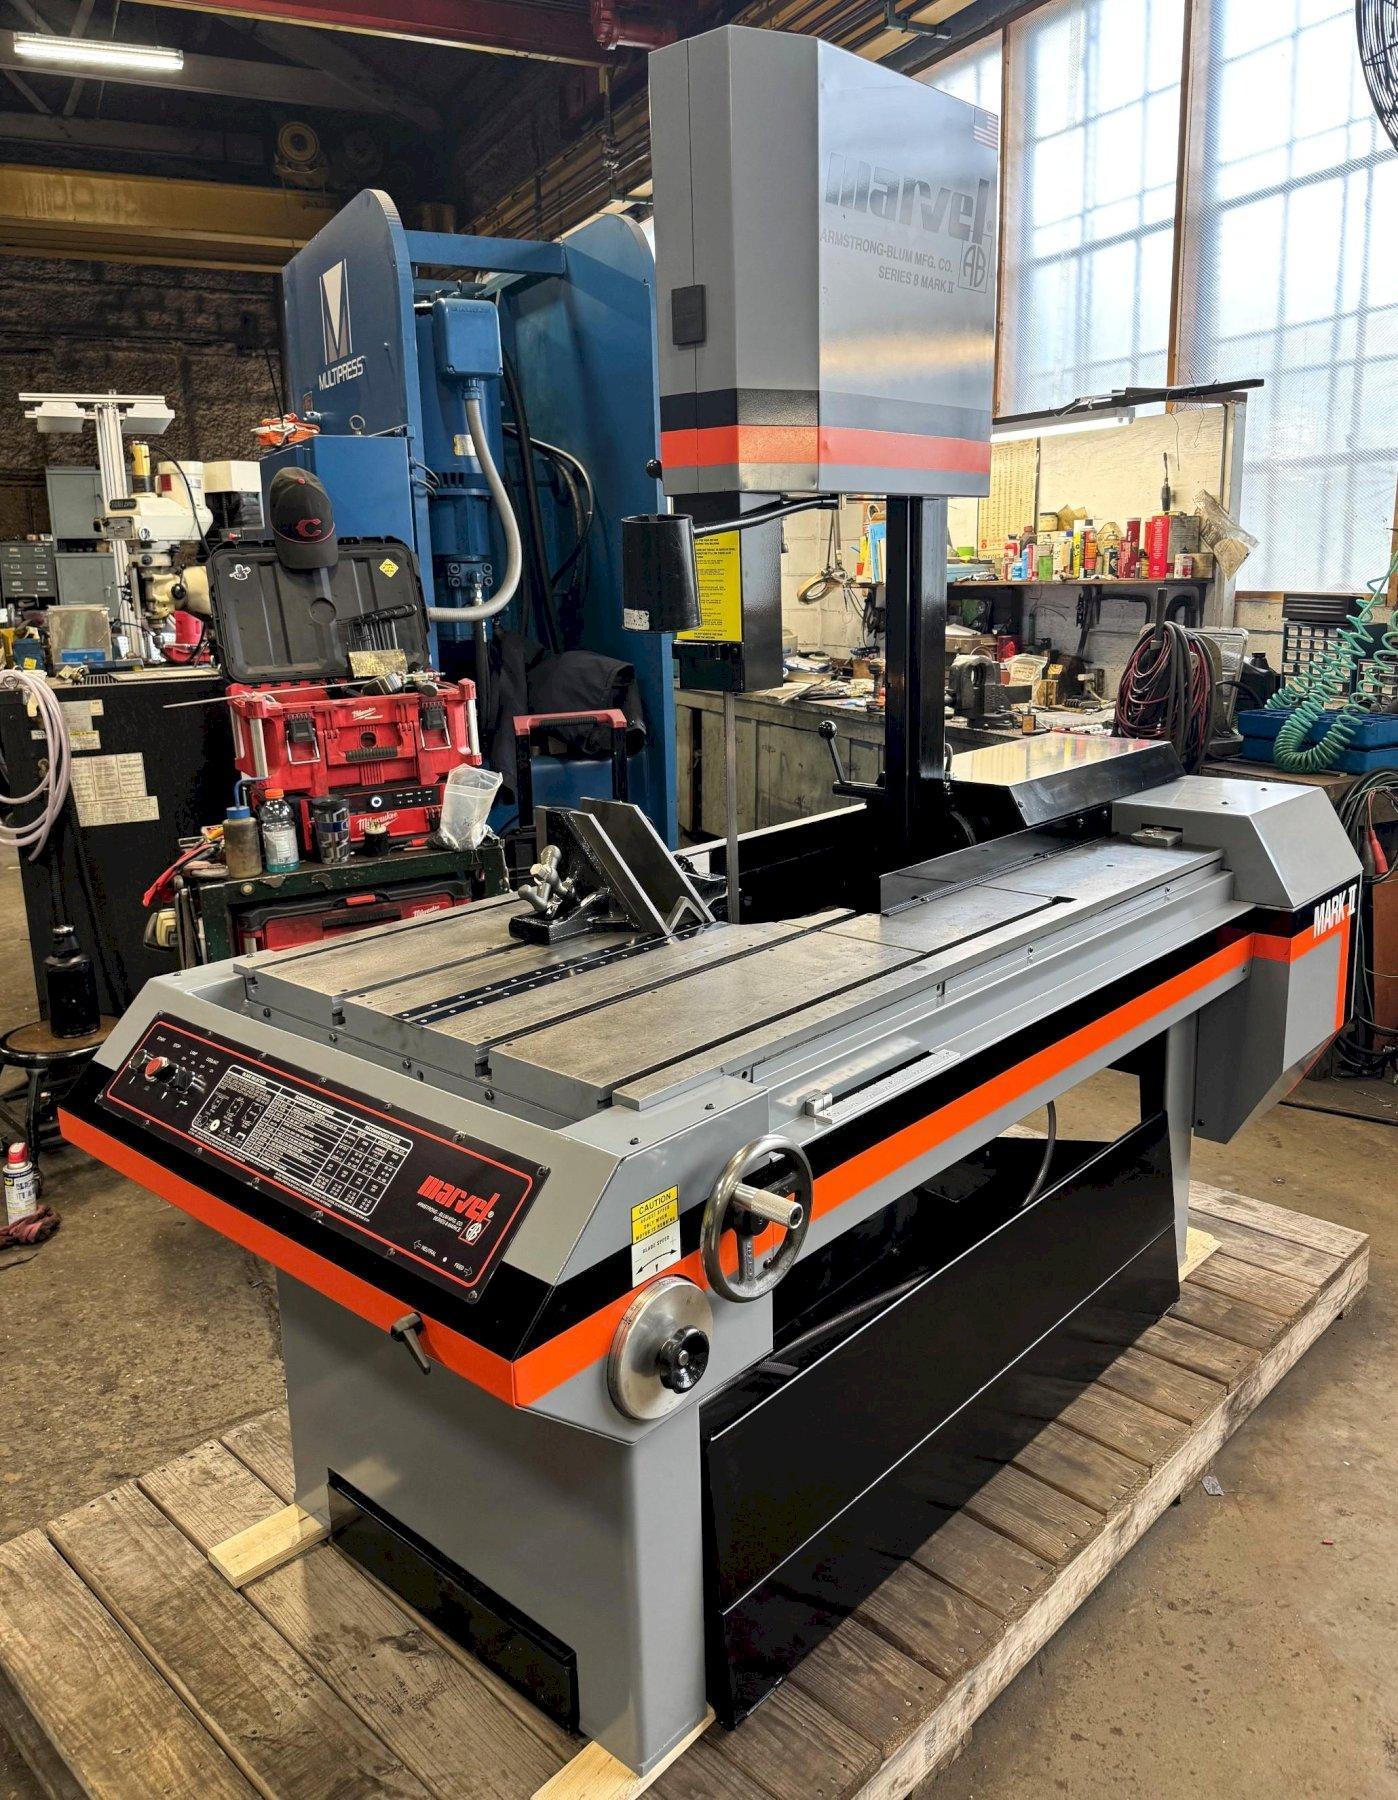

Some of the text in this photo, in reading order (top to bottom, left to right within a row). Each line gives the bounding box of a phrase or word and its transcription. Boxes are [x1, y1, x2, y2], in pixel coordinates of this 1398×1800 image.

[819, 228, 953, 273] ARMSTRONG-BLUM MFG. CO.
[878, 265, 956, 293] SERIES 8 MARK II
[318, 357, 364, 391] MULTIPRESS
[295, 518, 322, 537] C
[356, 811, 398, 831] Milwaukee
[1313, 883, 1358, 939] MARK II
[638, 1192, 672, 1215] CAUTION
